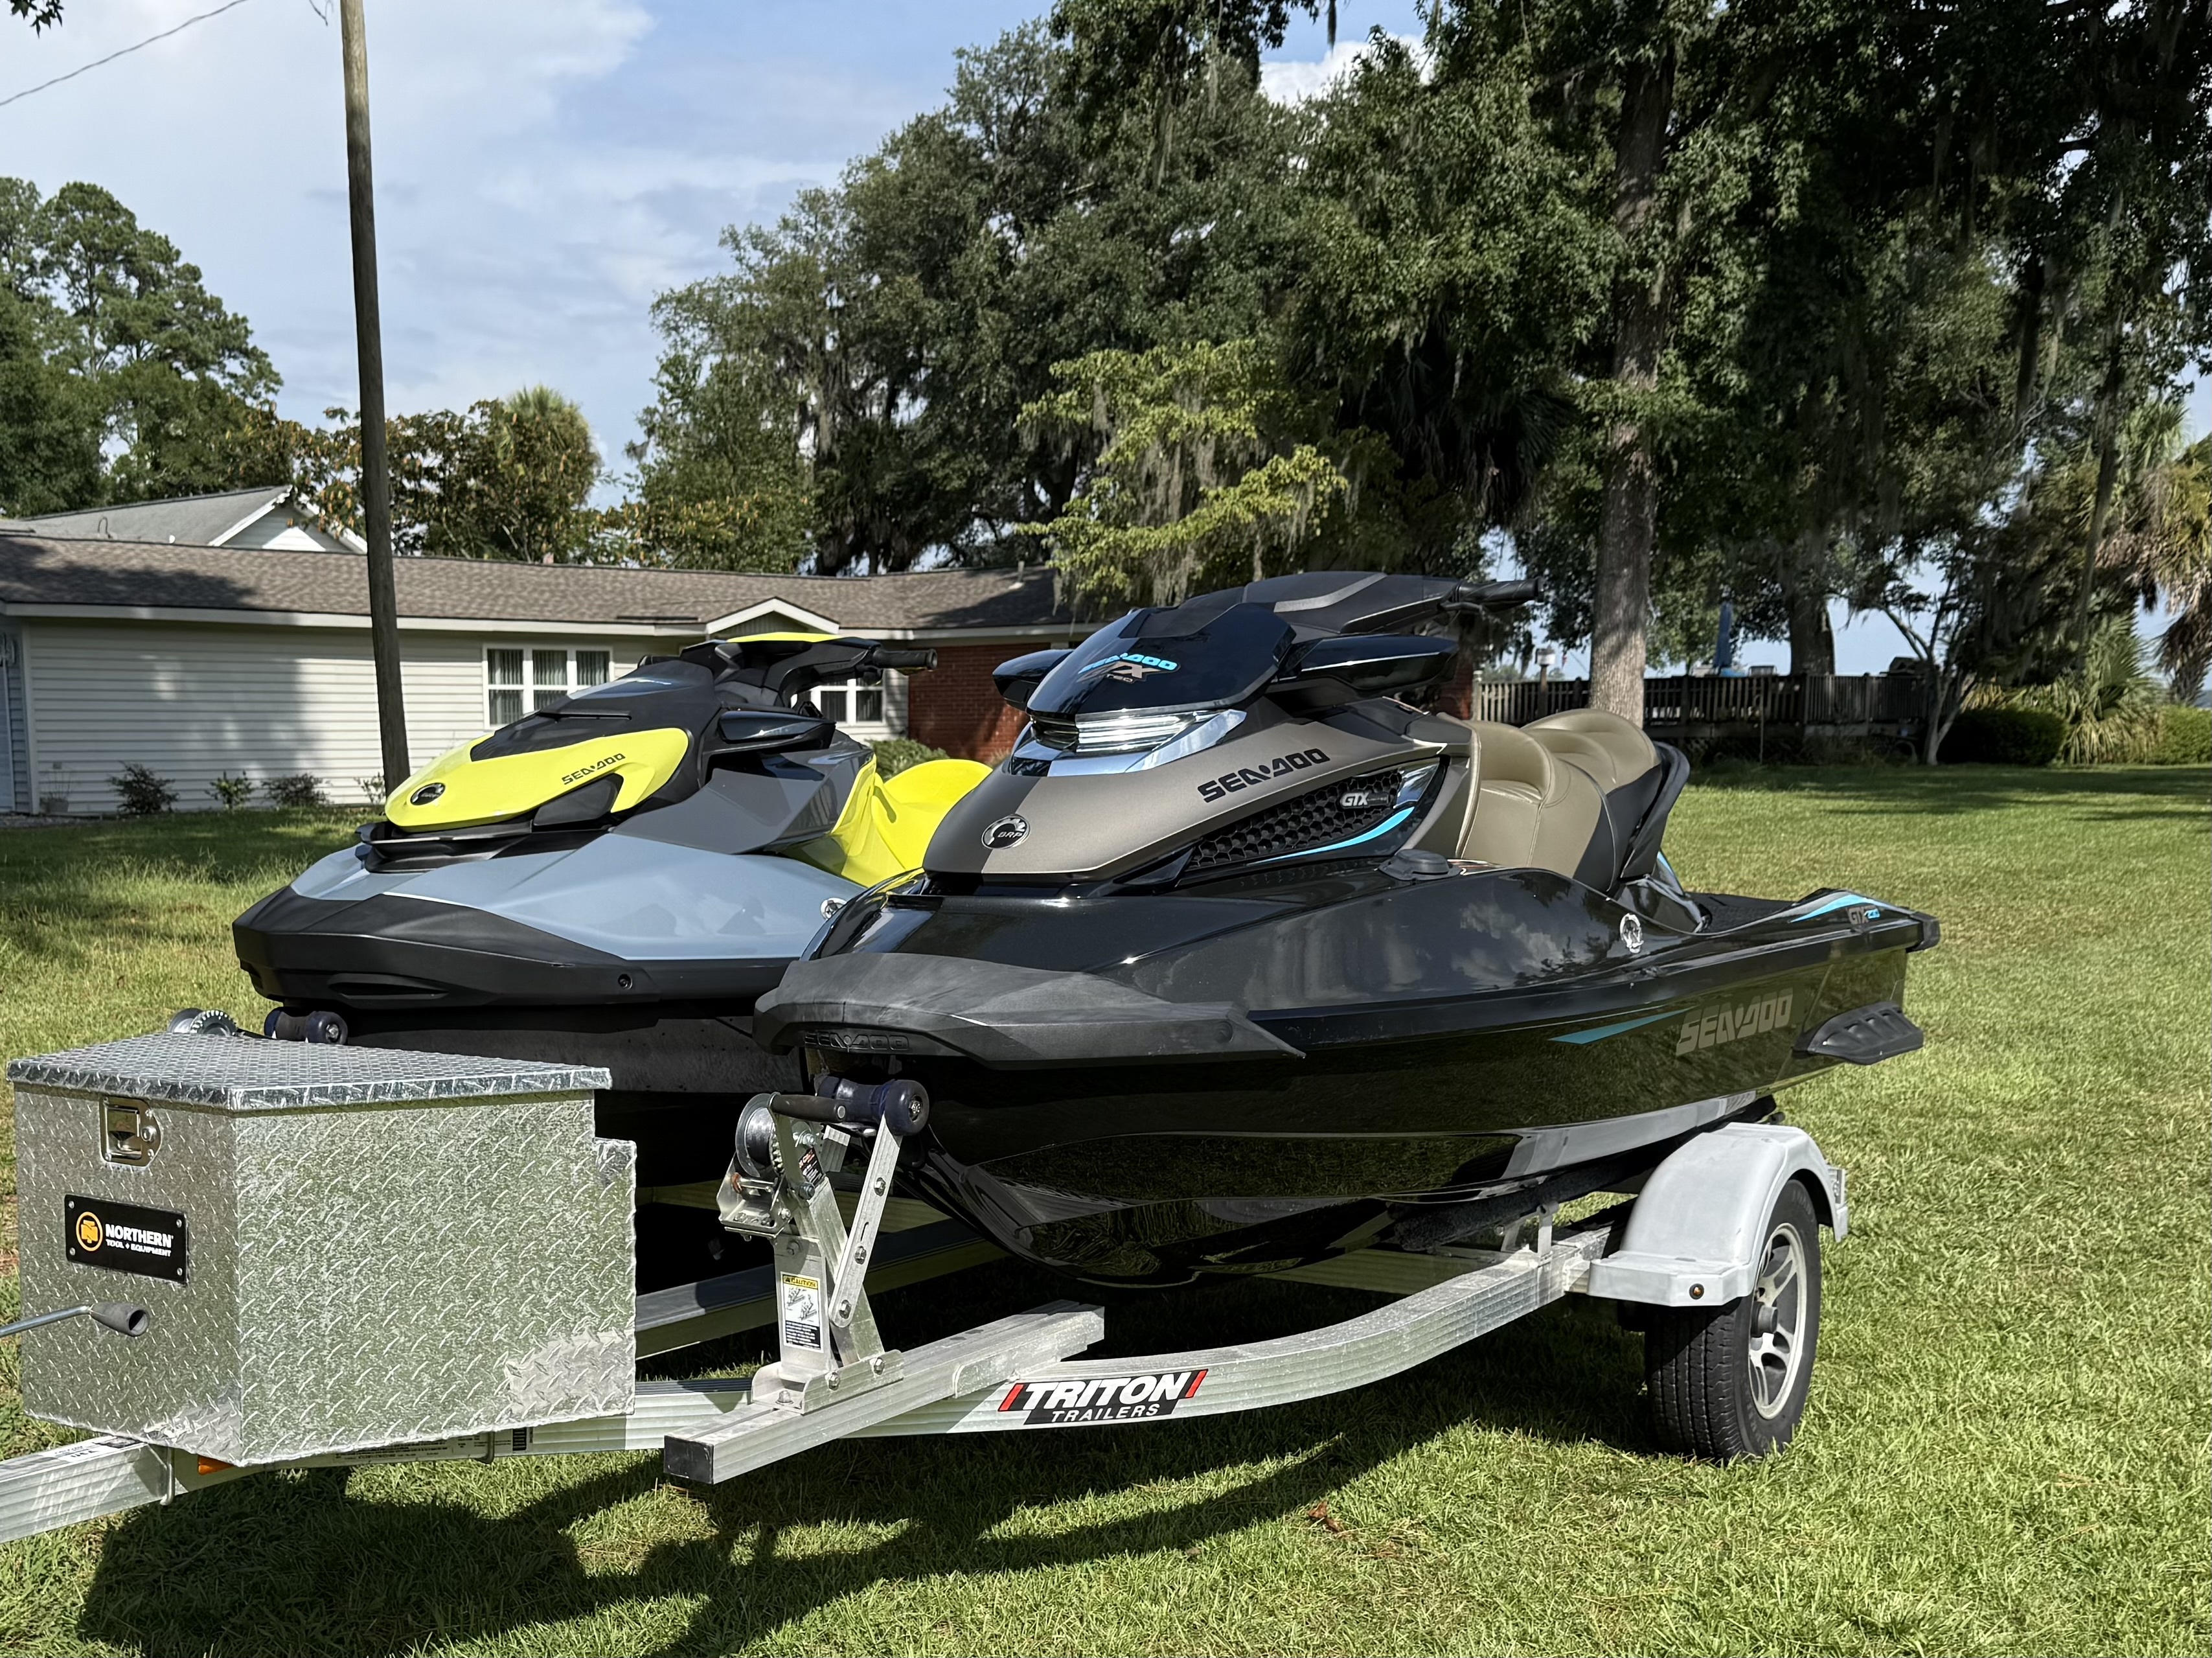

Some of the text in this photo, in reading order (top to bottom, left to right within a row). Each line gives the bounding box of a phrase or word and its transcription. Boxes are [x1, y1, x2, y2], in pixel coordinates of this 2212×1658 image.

[1340, 792, 1369, 806] GTX
[106, 1224, 172, 1249] NORTHERN
[106, 1239, 124, 1249] TOOL
[131, 1243, 171, 1257] EQUIPMENT
[1023, 1372, 1191, 1410] TRITON
[1051, 1403, 1160, 1422] TRAILERS
